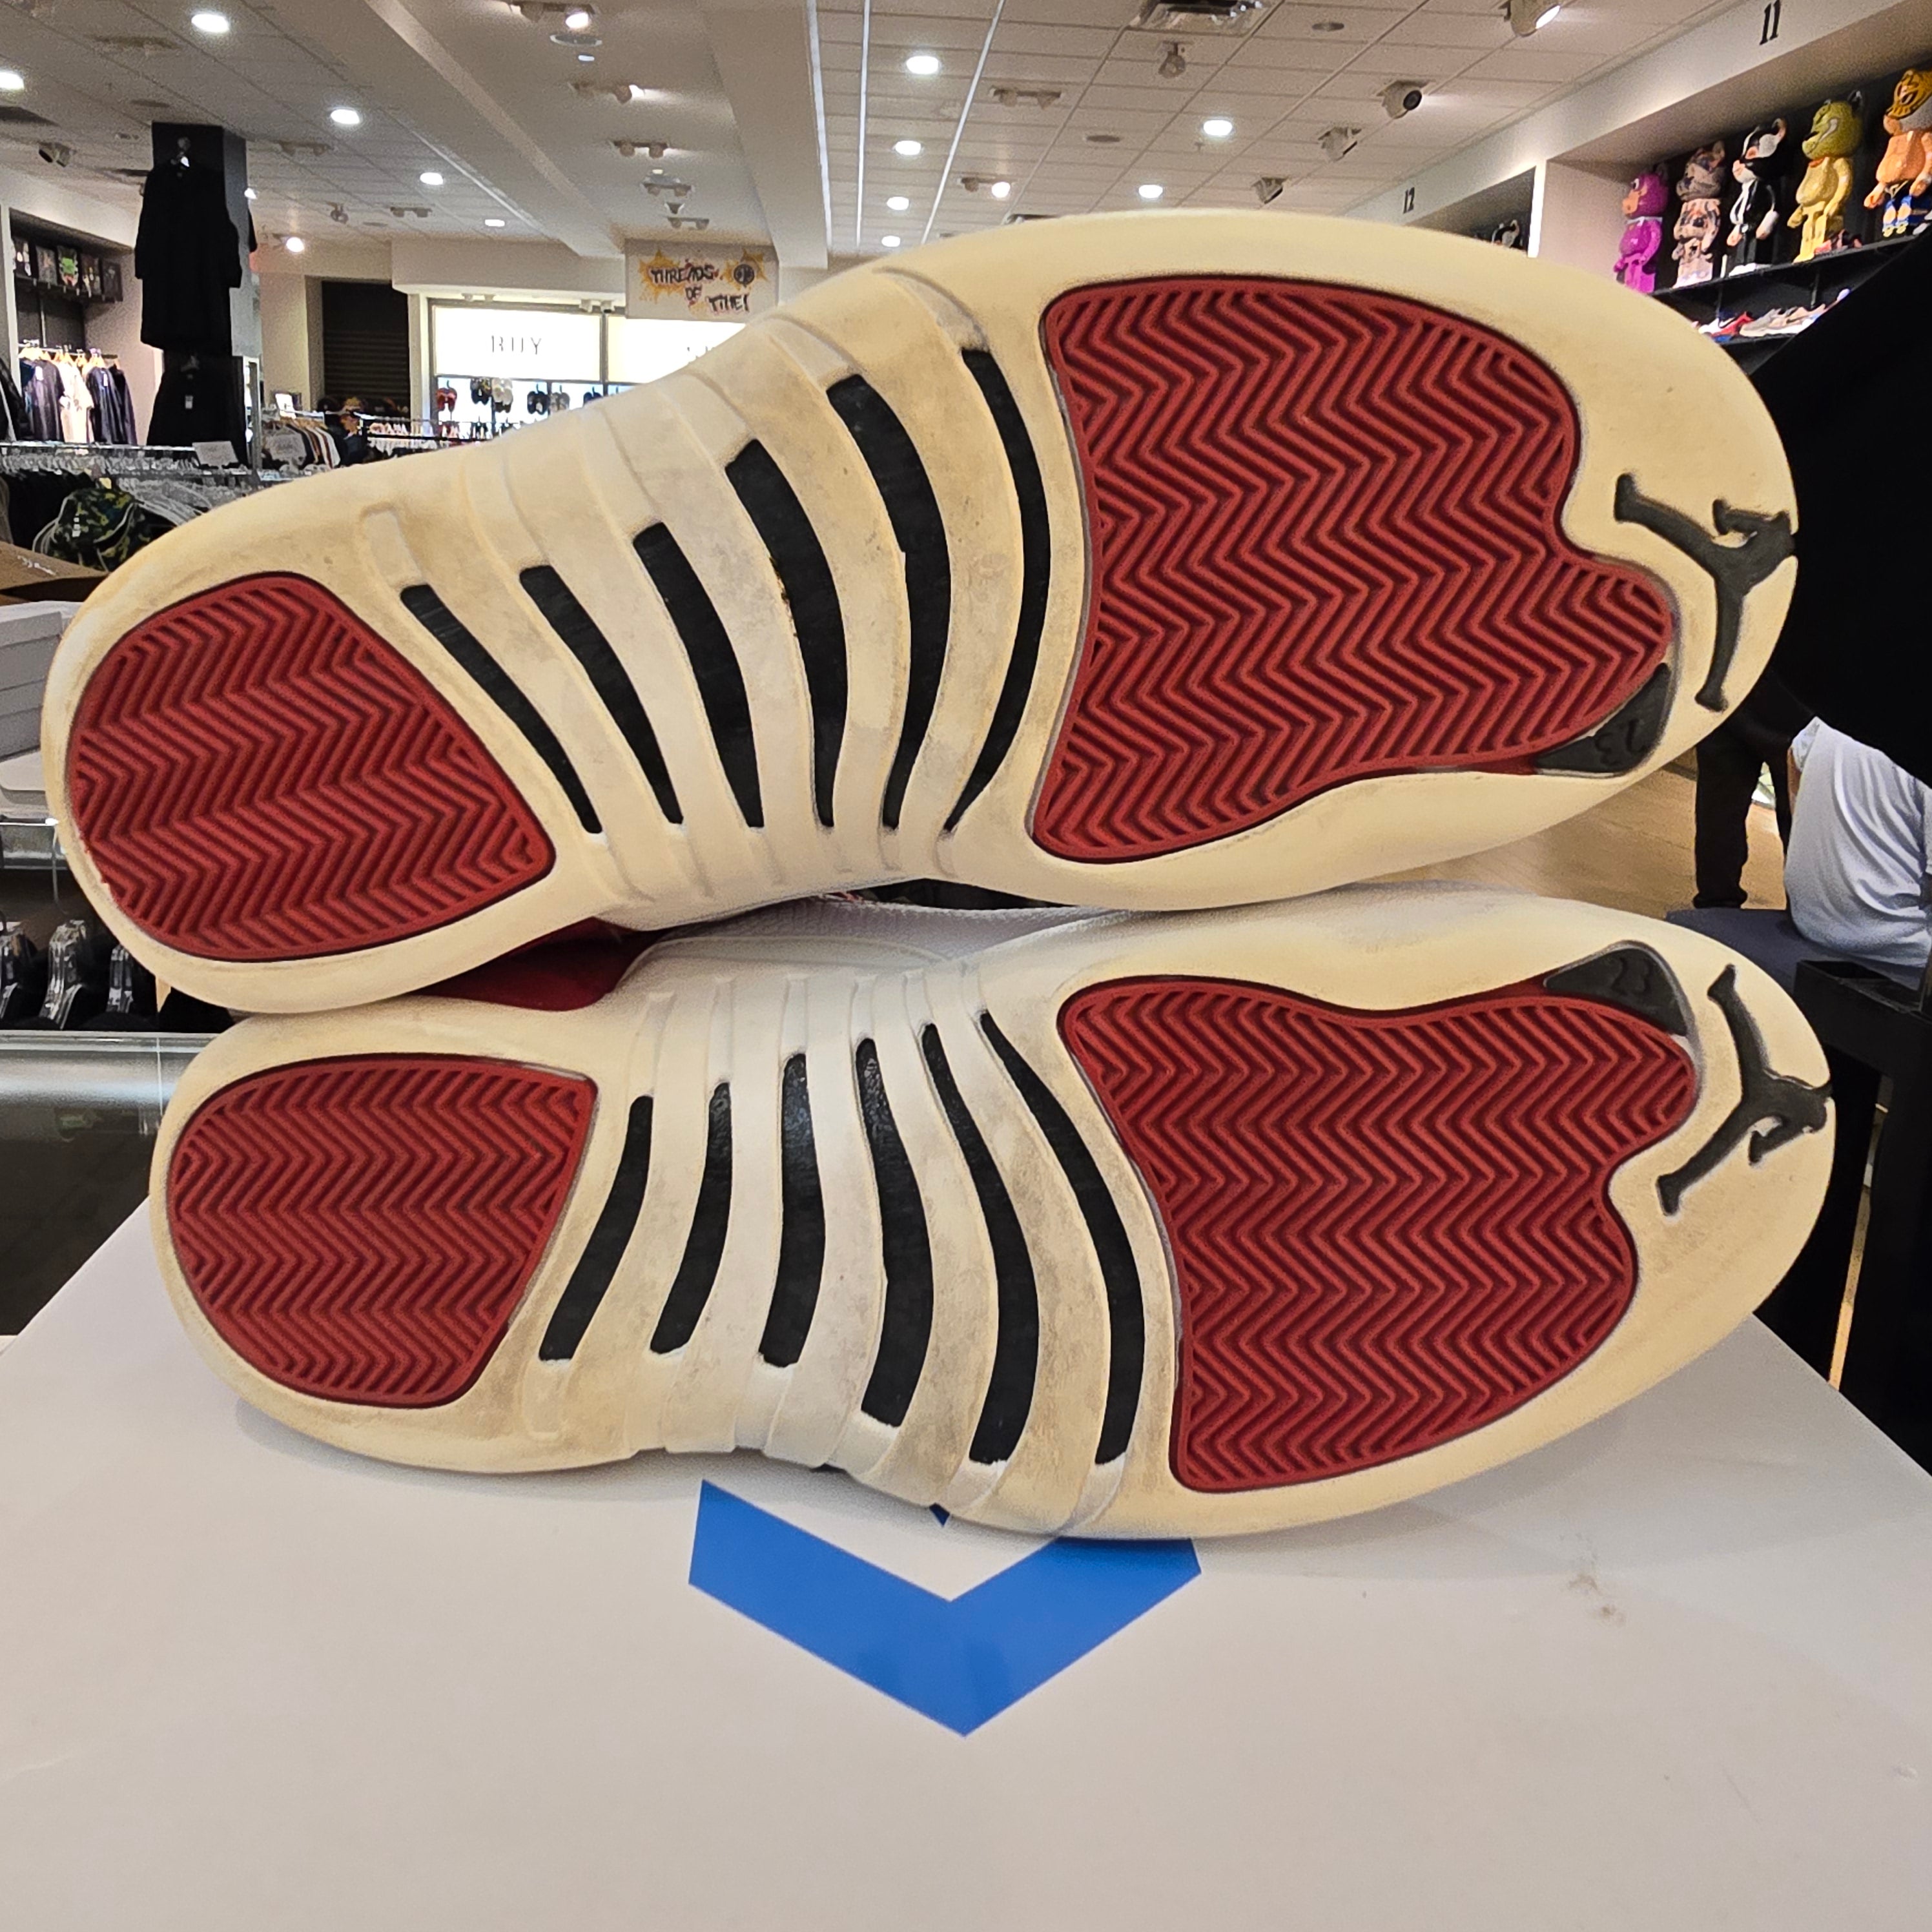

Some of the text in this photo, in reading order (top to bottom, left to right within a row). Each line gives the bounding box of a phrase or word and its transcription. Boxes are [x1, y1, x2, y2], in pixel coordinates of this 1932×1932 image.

[1759, 0, 1782, 45] 11
[650, 263, 714, 284] THREADS
[684, 285, 702, 300] OF
